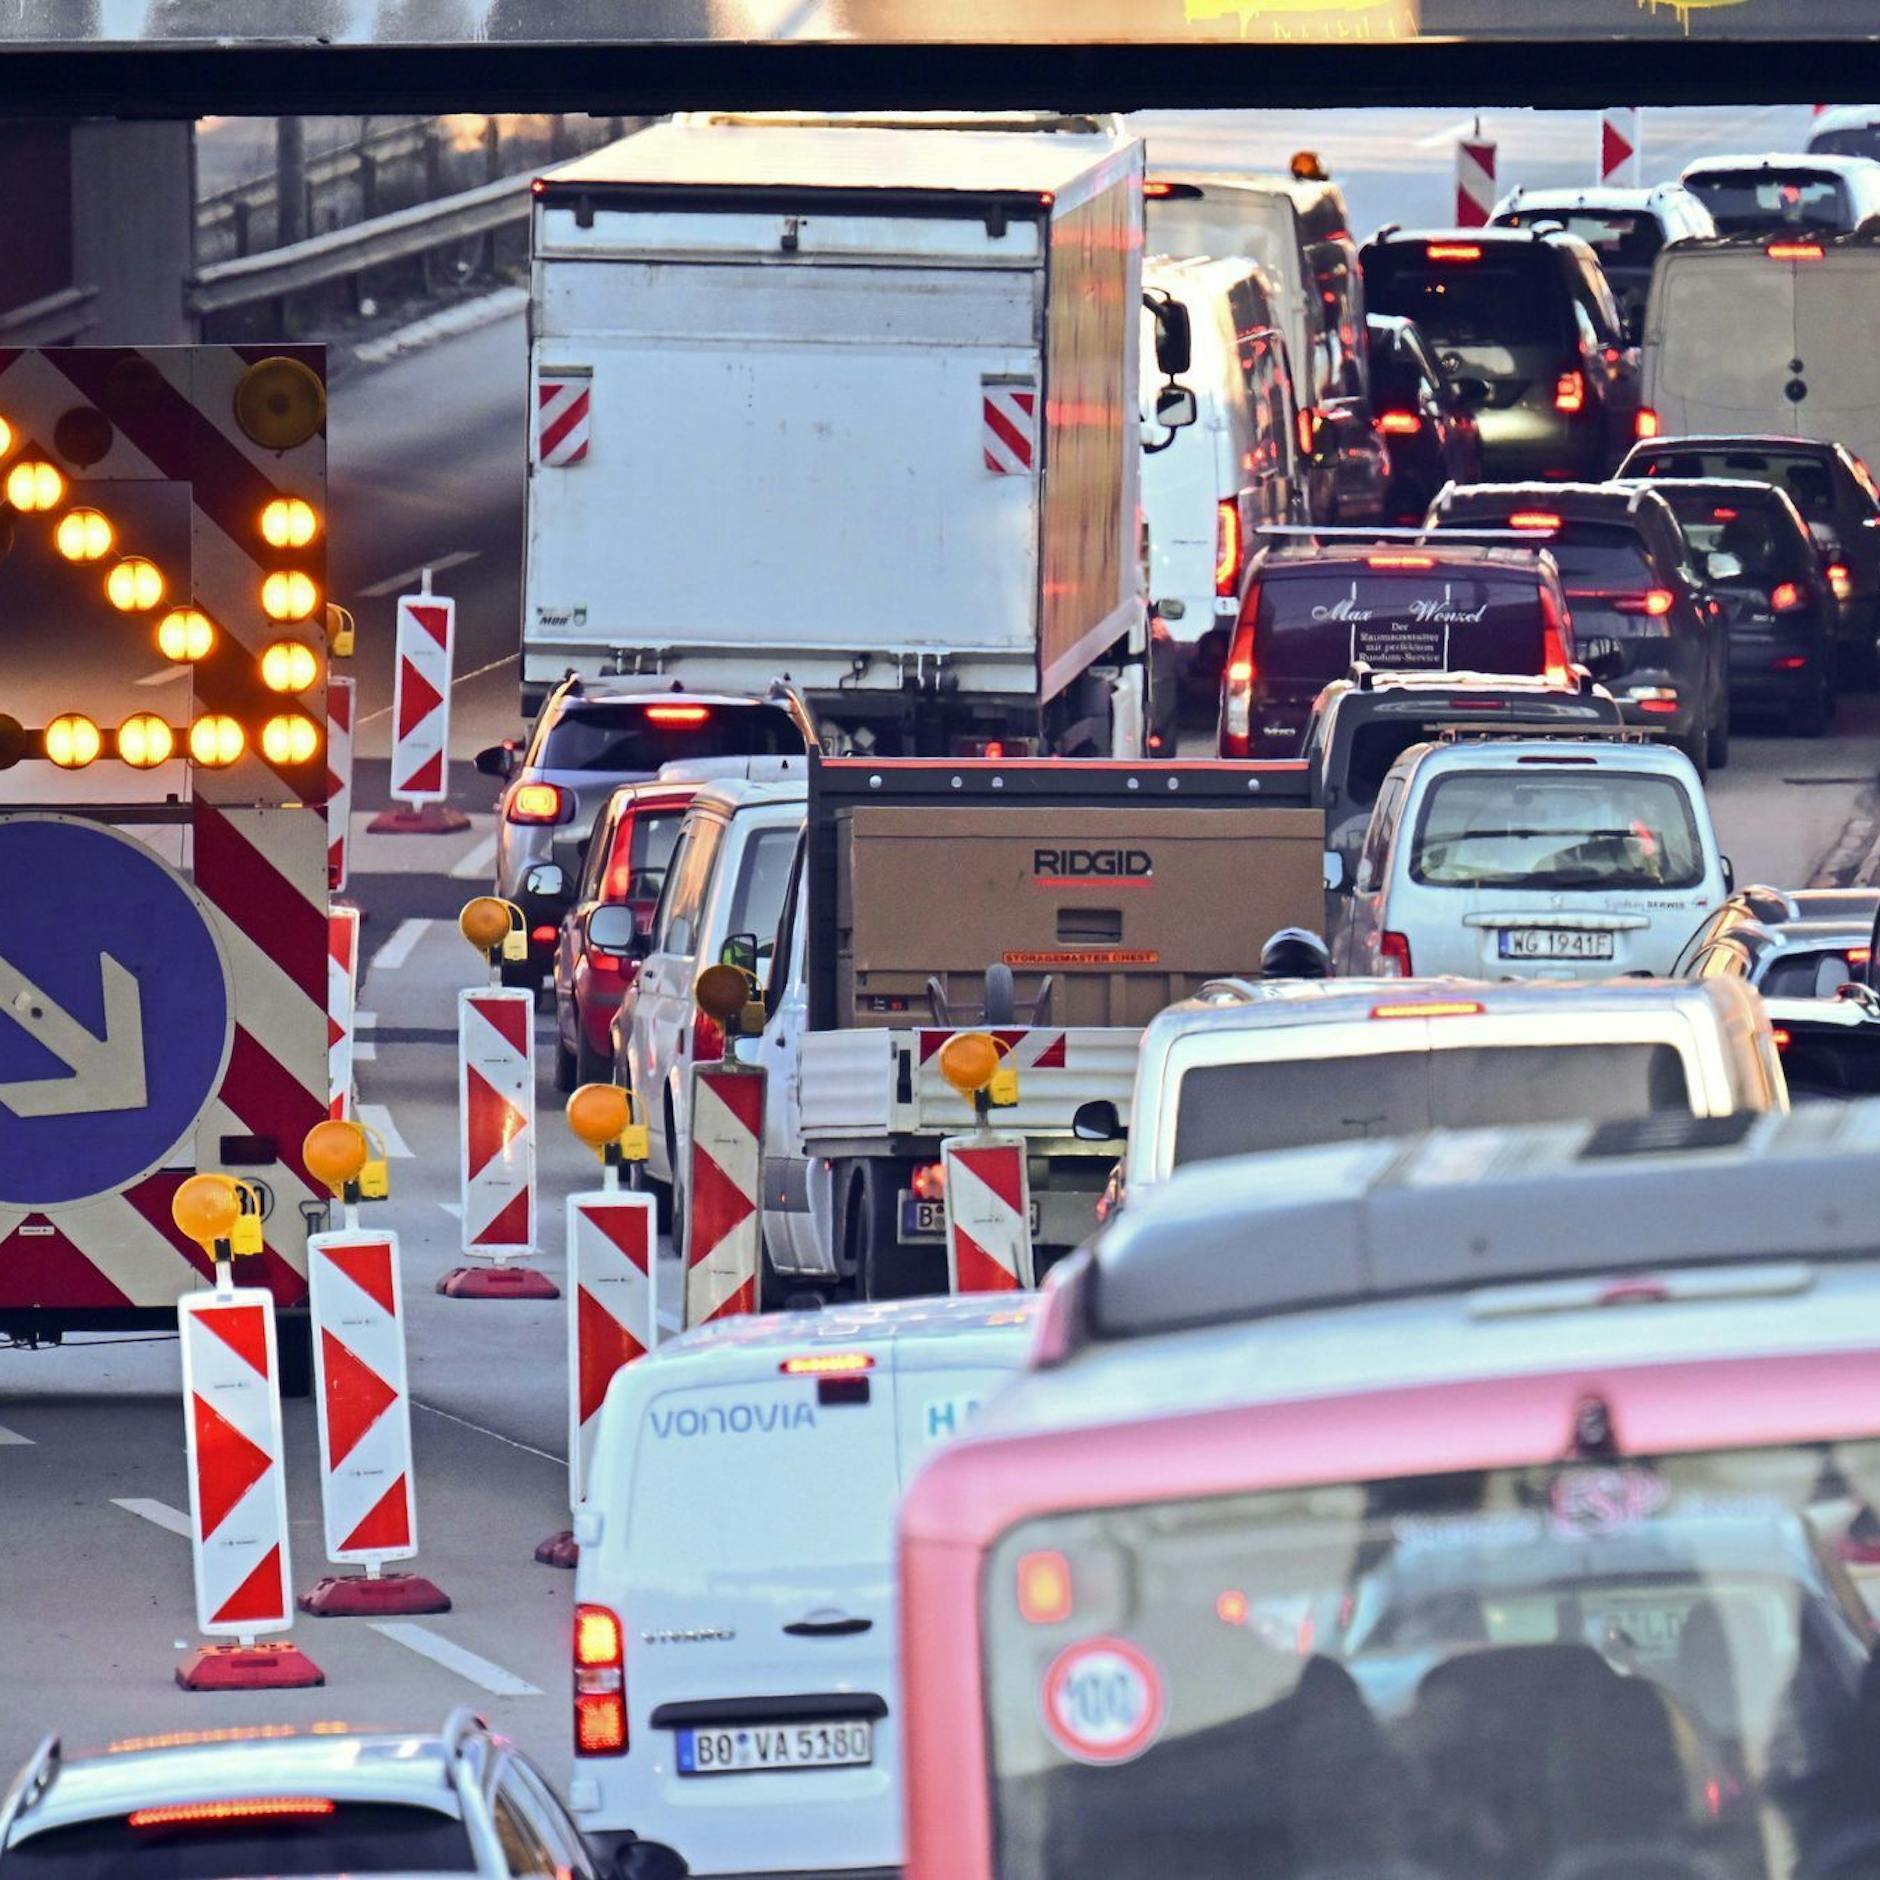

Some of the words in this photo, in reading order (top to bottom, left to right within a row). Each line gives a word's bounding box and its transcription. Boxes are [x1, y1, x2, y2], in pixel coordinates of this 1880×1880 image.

[1311, 599, 1373, 622] Max
[1408, 599, 1488, 623] Wenzel
[1391, 622, 1409, 631] Der
[1033, 848, 1152, 876] RIDGID
[1513, 931, 1538, 954] WG
[1548, 930, 1609, 954] 1941F
[1005, 952, 1109, 963] STORAGEMASTER
[1111, 951, 1152, 962] CHEST
[755, 1732, 790, 1762] VA
[797, 1727, 867, 1759] 5180
